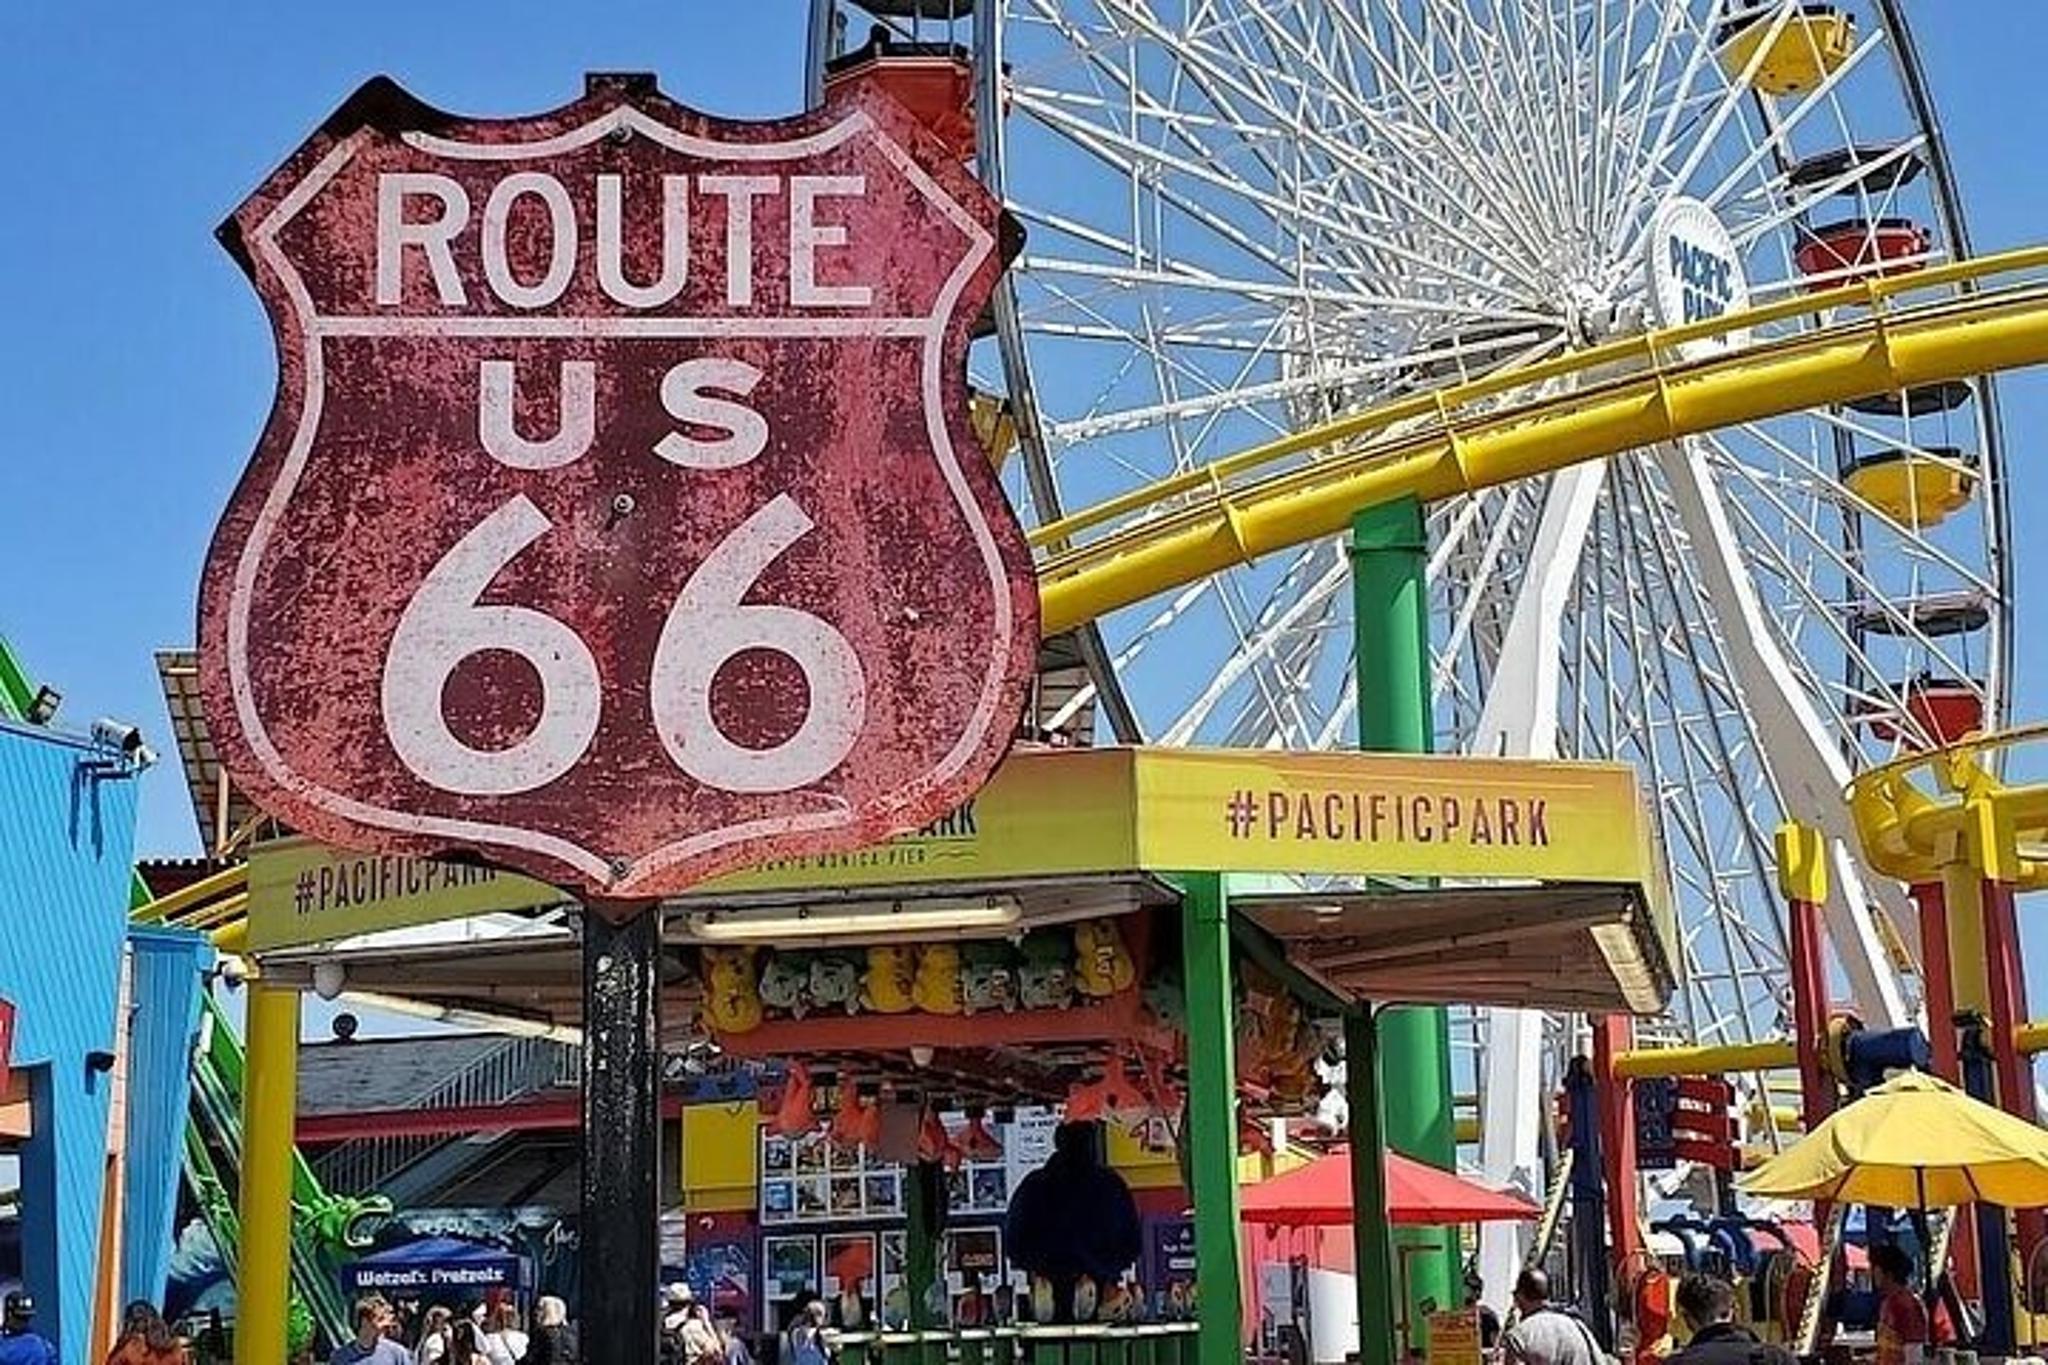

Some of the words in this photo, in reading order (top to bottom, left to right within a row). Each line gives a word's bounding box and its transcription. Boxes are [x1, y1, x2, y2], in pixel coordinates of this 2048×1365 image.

[374, 172, 873, 309] ROUTE
[1668, 234, 1734, 303] PACIFIC
[381, 492, 866, 795] 66
[1225, 789, 1549, 847] #PACIFICPARK
[816, 852, 879, 869] MONICA
[889, 848, 926, 866] PIER
[356, 1269, 429, 1287] Wetzel's
[431, 1267, 505, 1284] Pretzels
